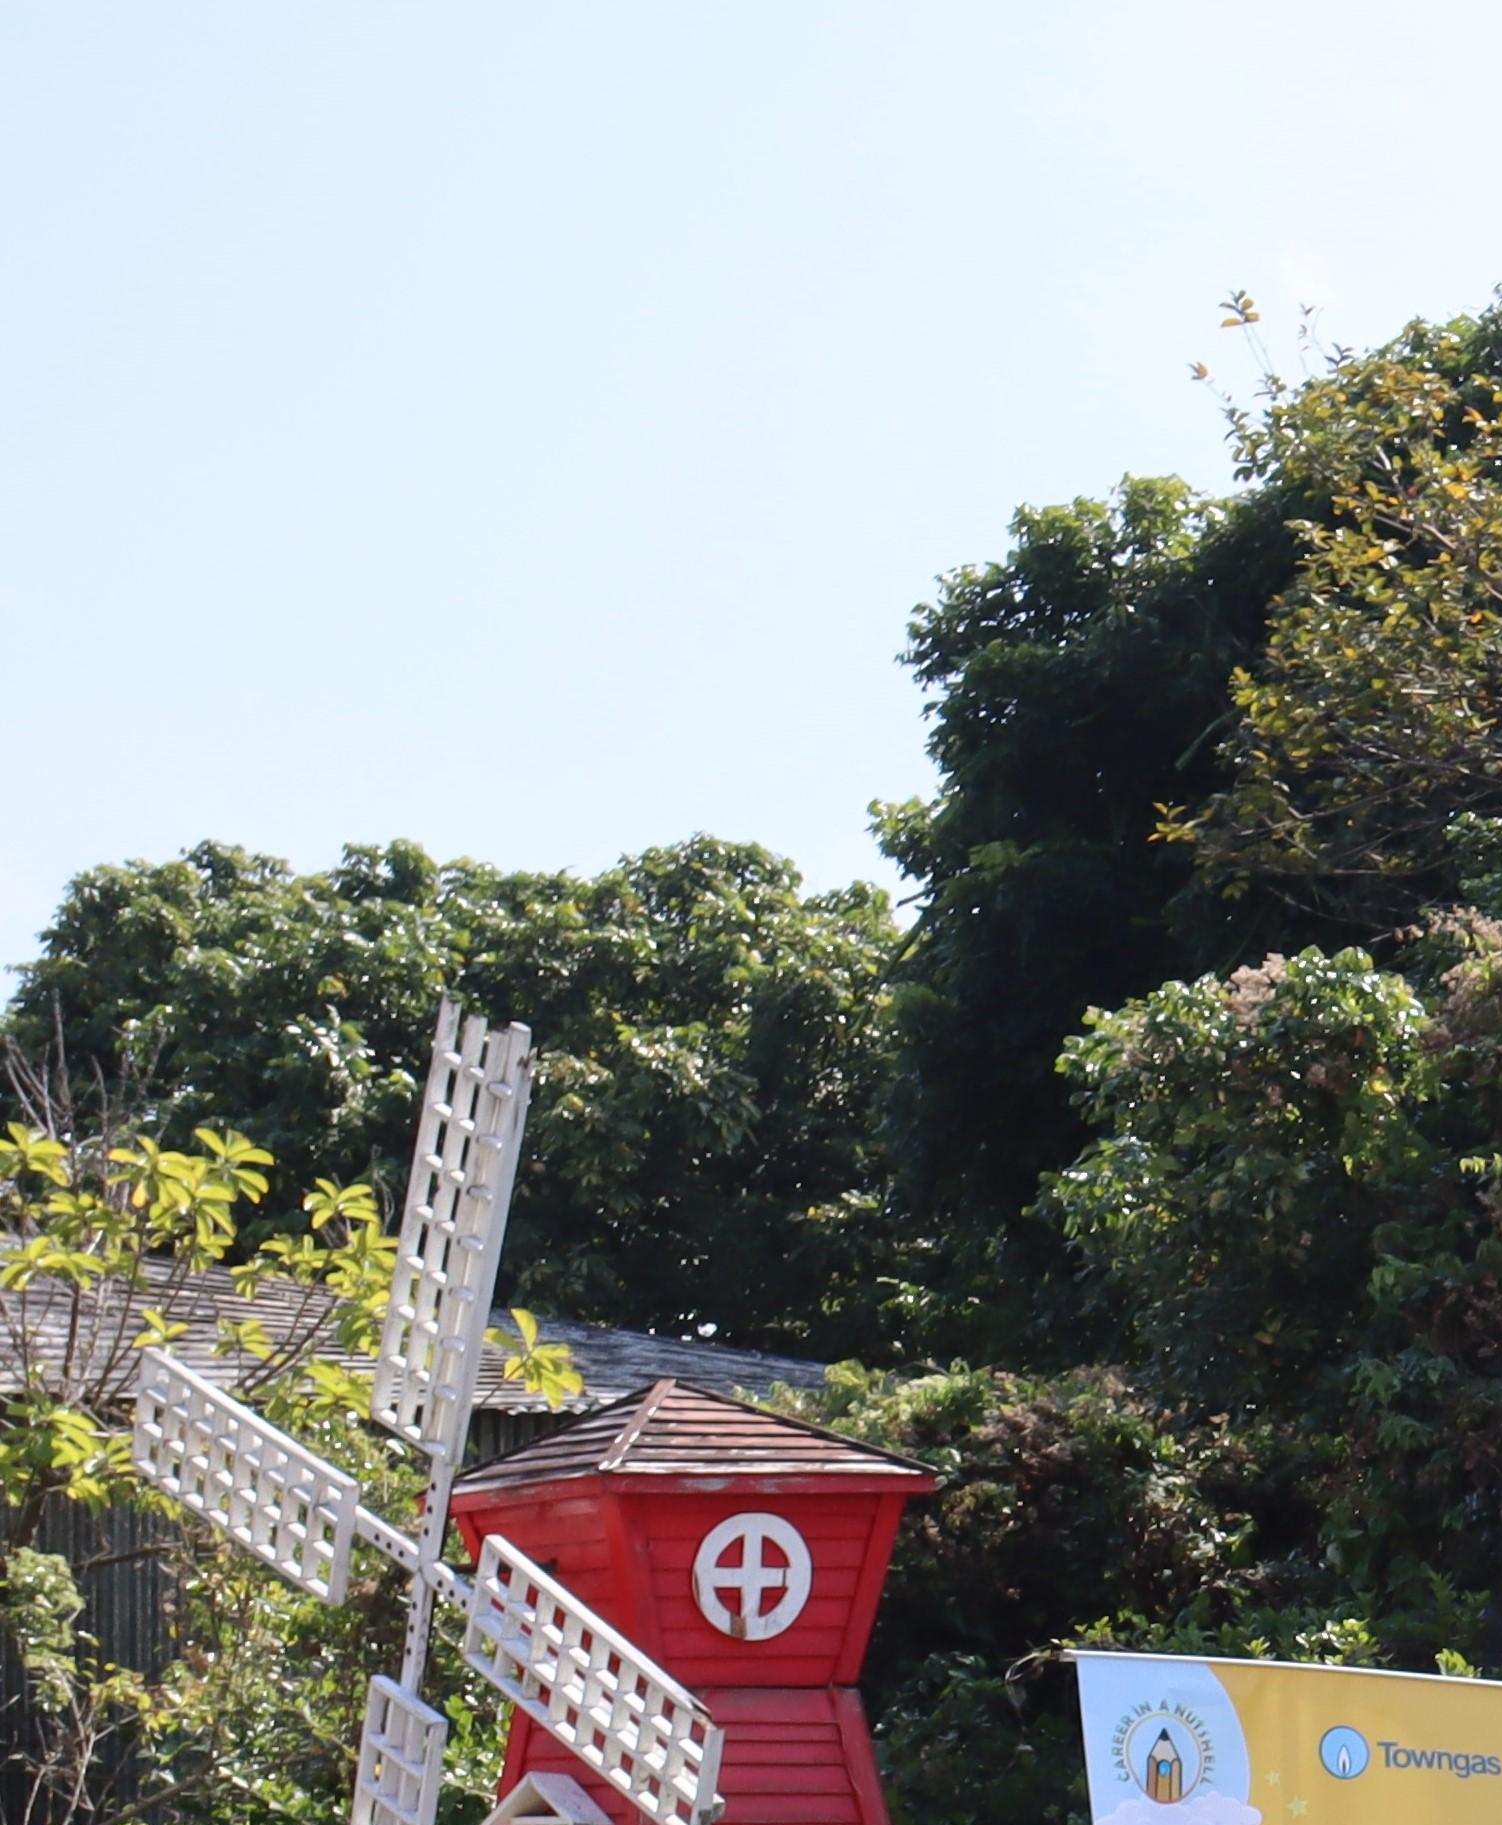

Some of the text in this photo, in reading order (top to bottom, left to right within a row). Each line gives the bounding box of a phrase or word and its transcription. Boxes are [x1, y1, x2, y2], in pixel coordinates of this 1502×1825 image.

[1111, 1714, 1135, 1783] CAREER
[1131, 1700, 1153, 1718] IN
[1158, 1698, 1170, 1712] A
[1377, 1741, 1502, 1778] Towngas
